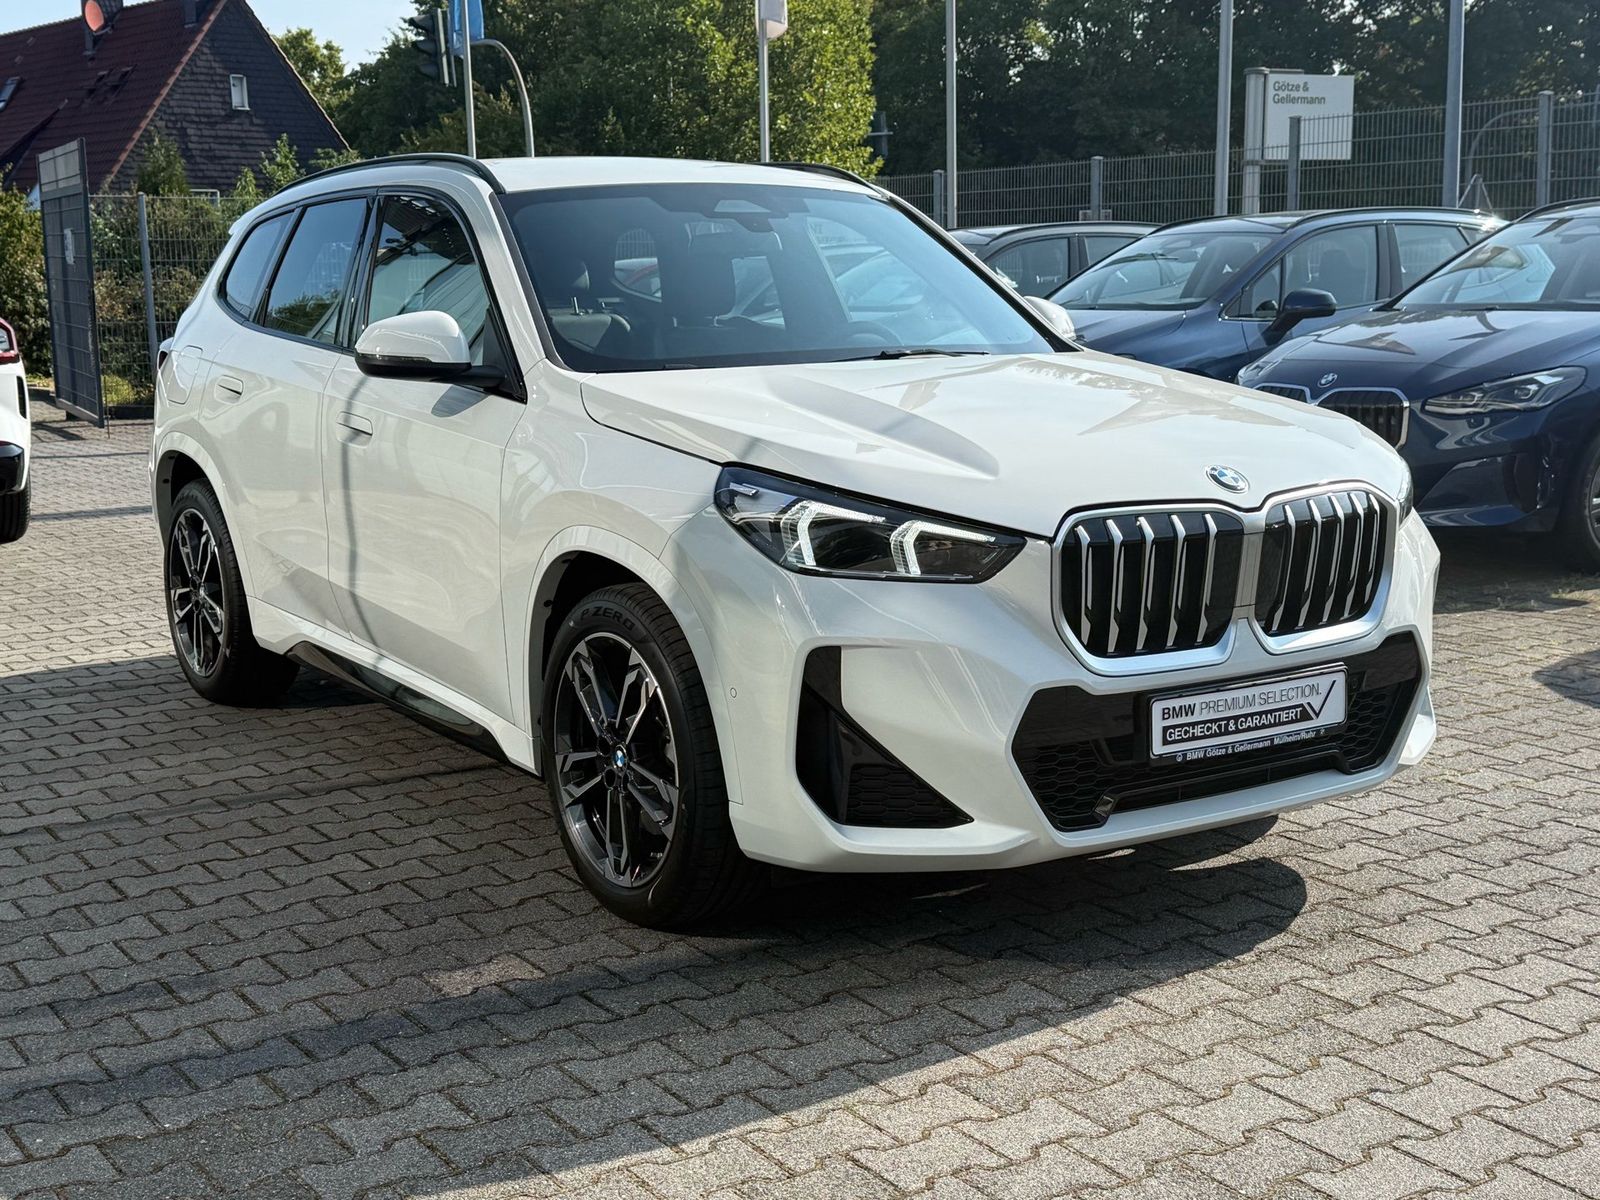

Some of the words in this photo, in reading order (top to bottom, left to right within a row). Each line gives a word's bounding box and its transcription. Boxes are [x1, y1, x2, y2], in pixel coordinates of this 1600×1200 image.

[1272, 80, 1300, 92] Götze
[1302, 81, 1310, 92] &
[1272, 93, 1326, 105] Gellermann
[592, 605, 636, 631] ZERO
[1162, 702, 1197, 721] BMW
[1199, 693, 1256, 716] PREMIUM
[1258, 682, 1322, 706] SELECTION.
[1166, 720, 1227, 741] GECHECKT
[1228, 719, 1236, 732] &
[1237, 707, 1303, 730] GARANTIERT
[1186, 750, 1205, 761] BMW
[1206, 747, 1226, 757] Götze
[1227, 746, 1233, 754] &
[1234, 740, 1271, 753] Gellermann
